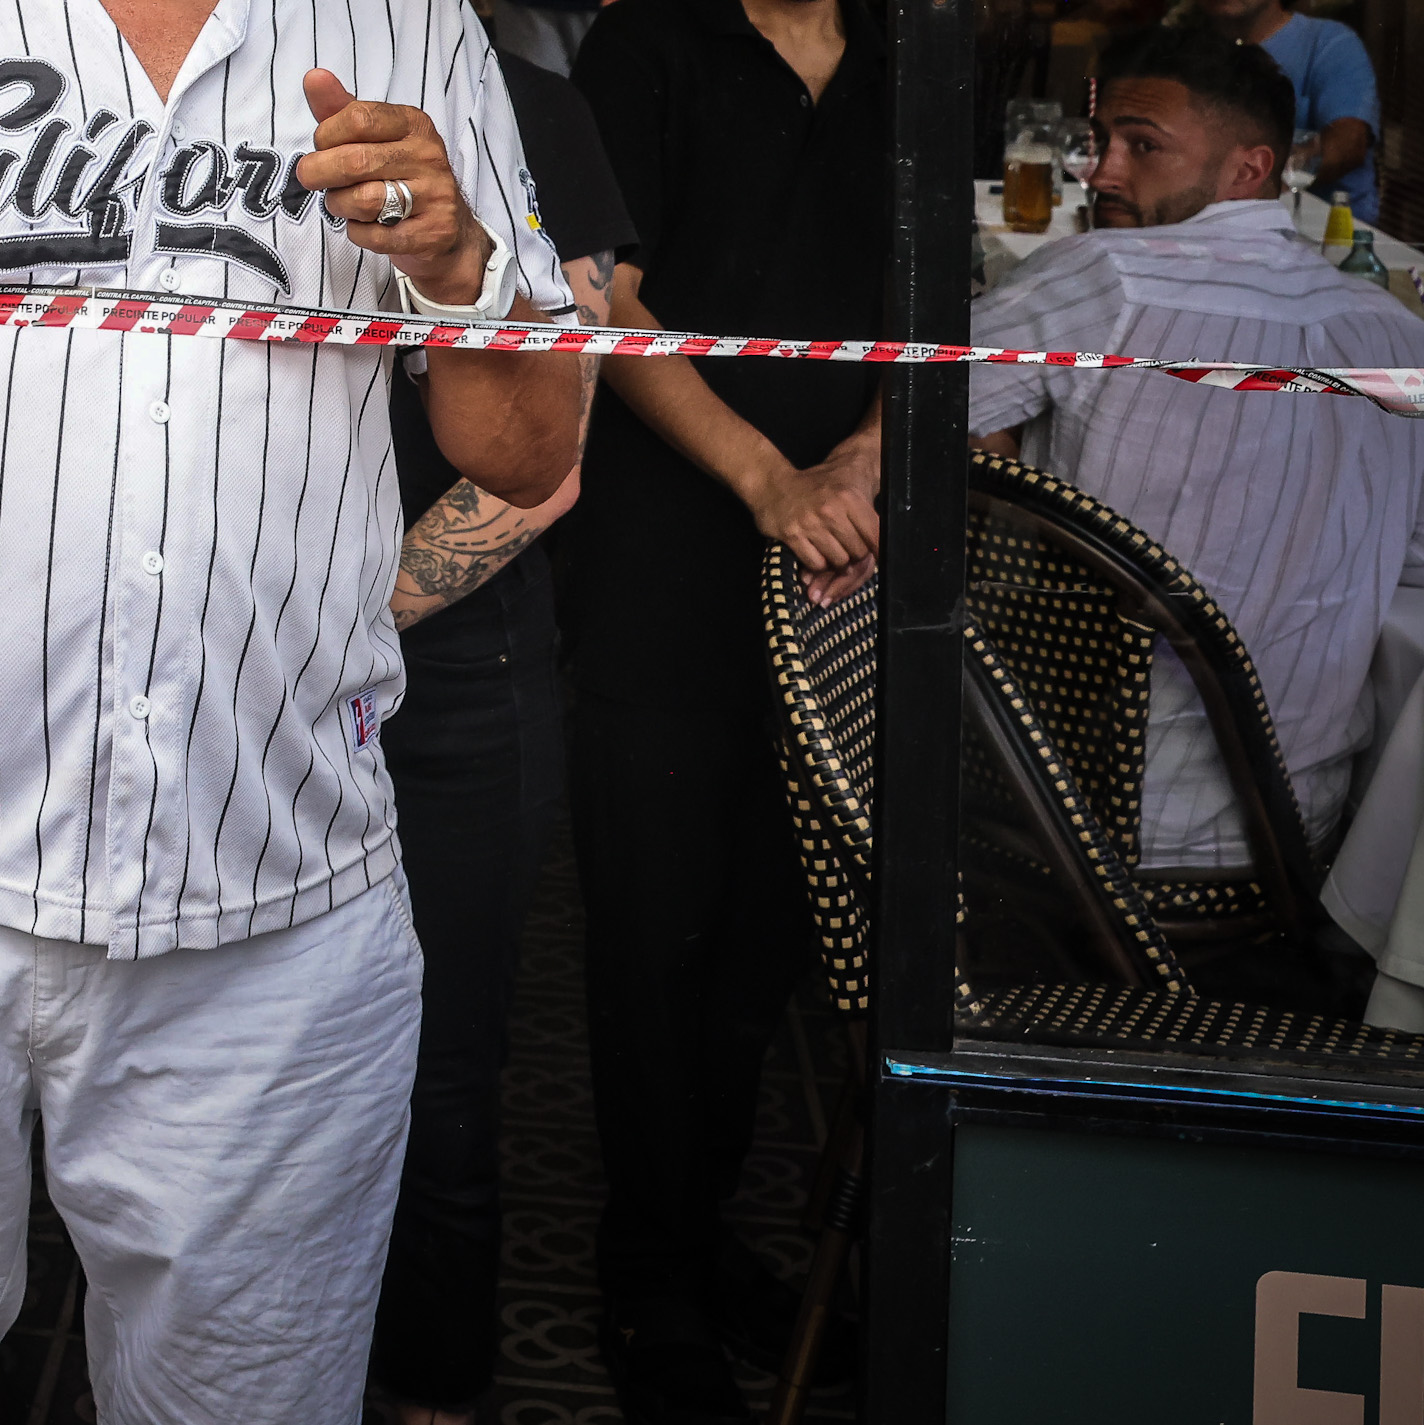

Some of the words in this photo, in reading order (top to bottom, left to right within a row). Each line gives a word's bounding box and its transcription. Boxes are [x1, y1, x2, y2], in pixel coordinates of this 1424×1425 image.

[35, 304, 88, 315] POPULAR
[103, 307, 159, 320] PRECINTE
[162, 311, 216, 324] POPULAR
[229, 317, 285, 330] PRECINTE
[288, 321, 342, 335] POPULAR
[355, 327, 411, 340] PRECINTE
[97, 291, 122, 299] CONTRA
[131, 294, 156, 302] CAPITAL
[159, 296, 184, 304] CONTRA
[193, 299, 219, 307] CAPITAL
[221, 302, 246, 310] CONTRA
[247, 303, 255, 311] EL
[255, 304, 282, 313] CAPITAL
[284, 308, 309, 316] CONTRA
[318, 311, 344, 319] CAPITAL
[347, 314, 372, 322] CONTRA
